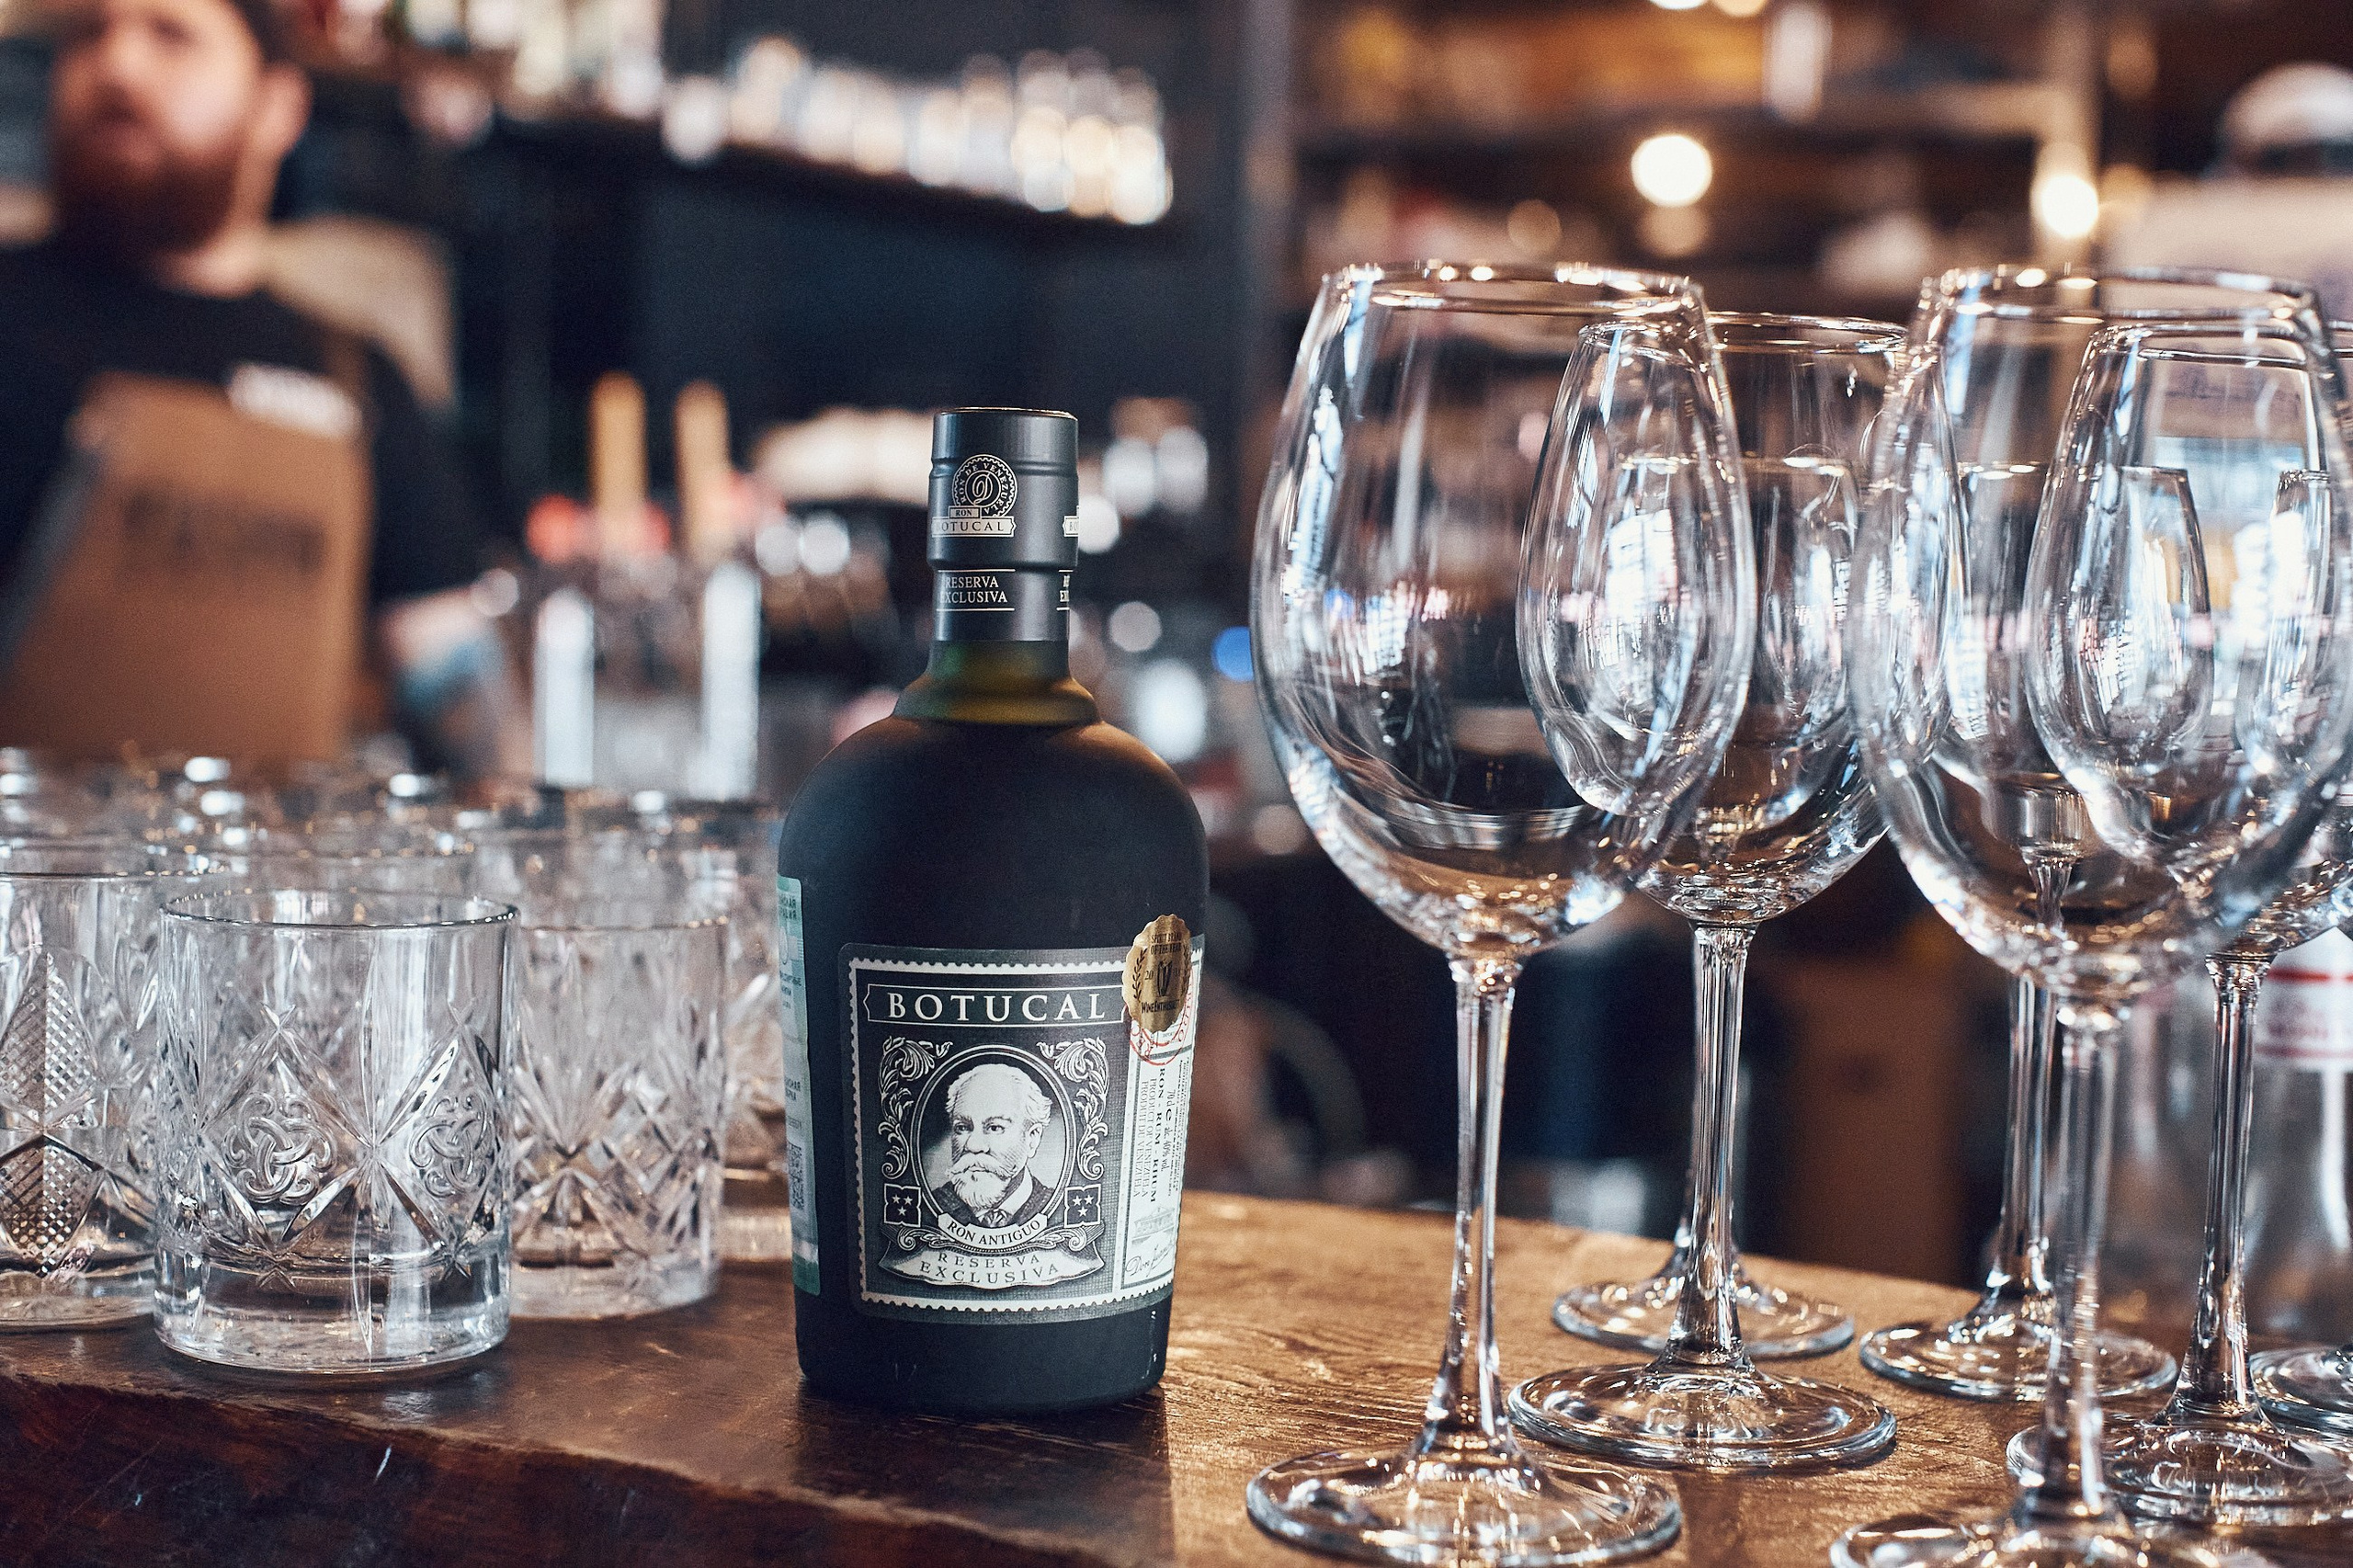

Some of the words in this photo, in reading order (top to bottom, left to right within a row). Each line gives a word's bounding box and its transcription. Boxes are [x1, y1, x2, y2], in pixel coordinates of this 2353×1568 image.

[965, 465, 979, 476] DE
[983, 462, 1009, 515] VENEZUELA
[944, 575, 999, 588] RESERVA
[940, 590, 1008, 604] EXCLUSIVA
[886, 992, 1105, 1023] BOTUCAL
[1139, 1081, 1149, 1122] PRODUIT
[1147, 1078, 1157, 1122] PRODUCT
[1167, 1089, 1176, 1099] 70
[1138, 1125, 1145, 1139] DU
[1146, 1126, 1154, 1139] OF
[1162, 1141, 1172, 1157] 40%
[1133, 1141, 1144, 1198] VENEZUELA
[1142, 1141, 1153, 1198] VENEZUELA
[1151, 1159, 1159, 1202] RHUM
[947, 1220, 975, 1242] RON
[978, 1220, 1040, 1245] ANTIGUO
[938, 1251, 1040, 1268] RESERVA
[920, 1260, 1059, 1284] EXCLUSIVA
